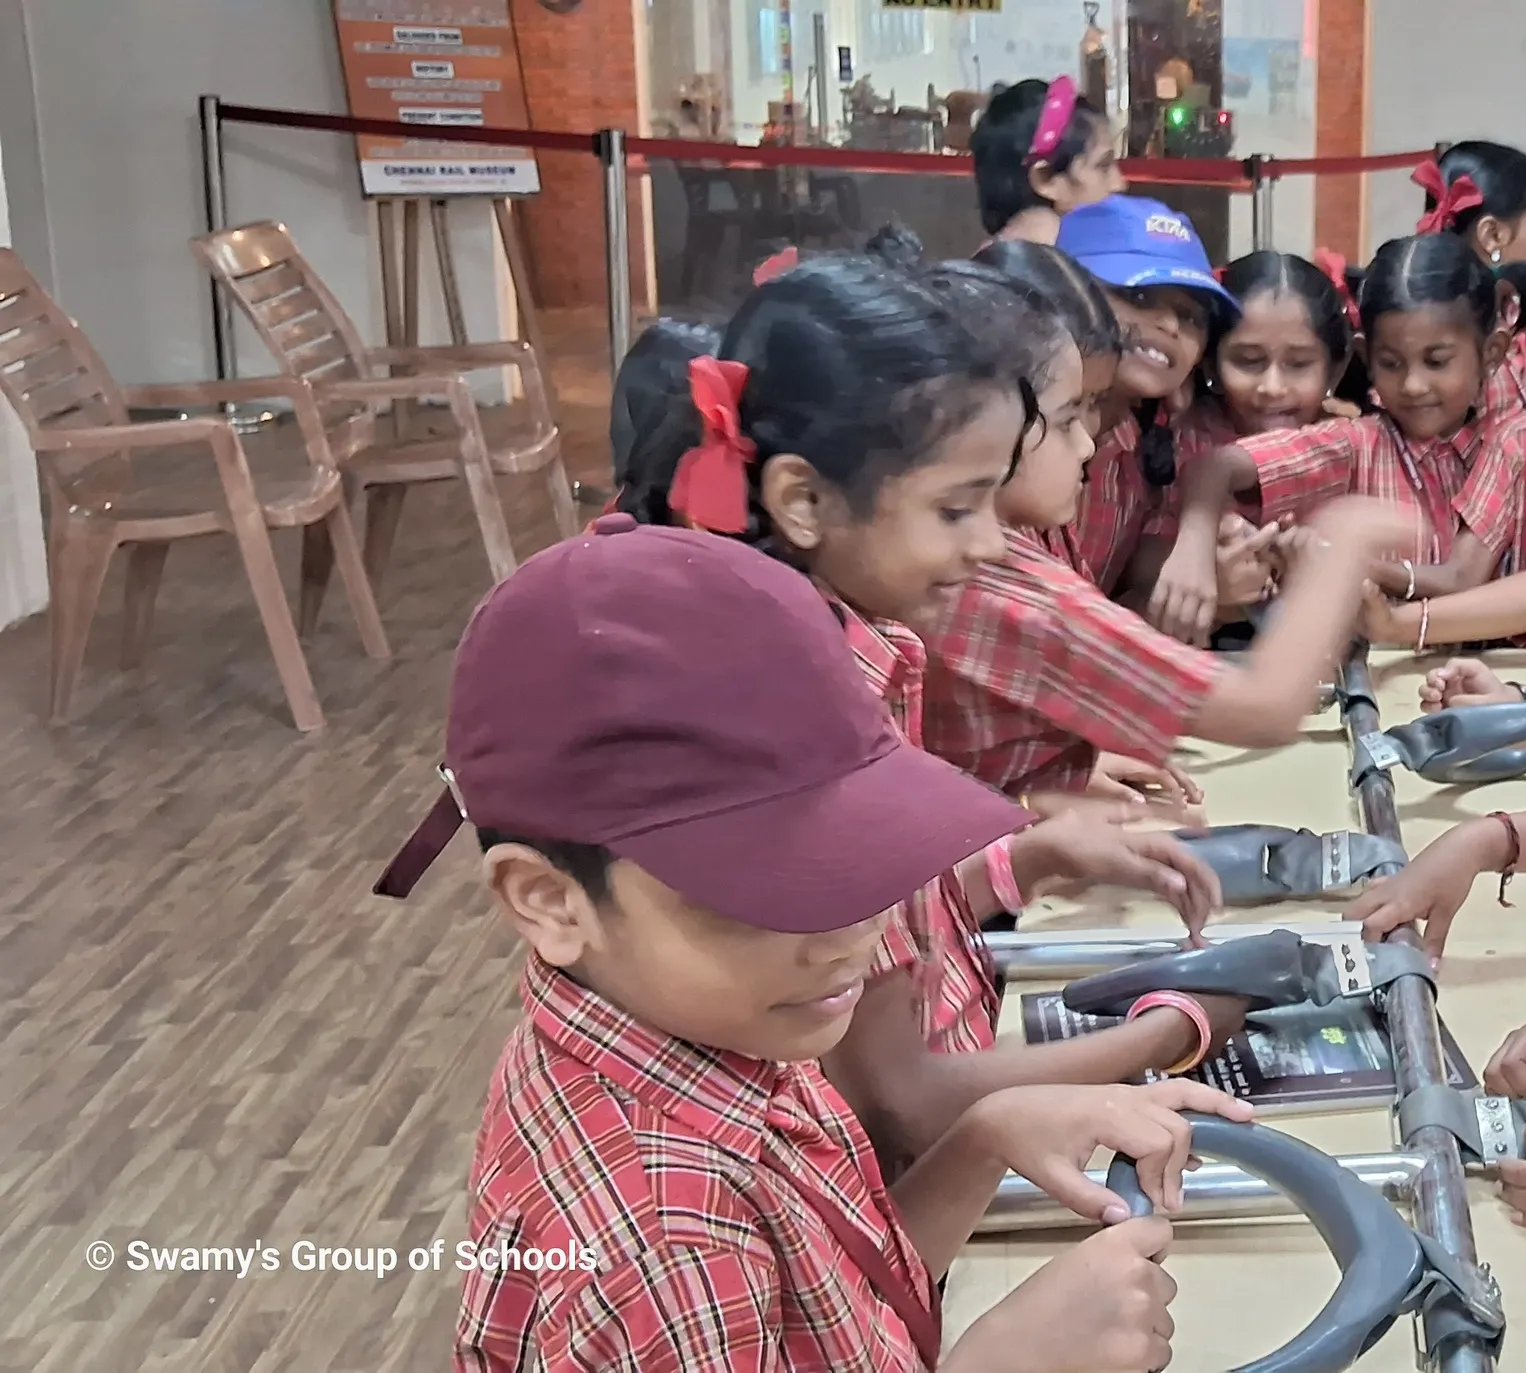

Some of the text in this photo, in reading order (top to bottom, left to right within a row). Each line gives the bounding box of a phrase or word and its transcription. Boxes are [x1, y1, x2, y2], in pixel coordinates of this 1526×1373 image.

[384, 164, 517, 177] CHENNAI RAIL MUSEUM
